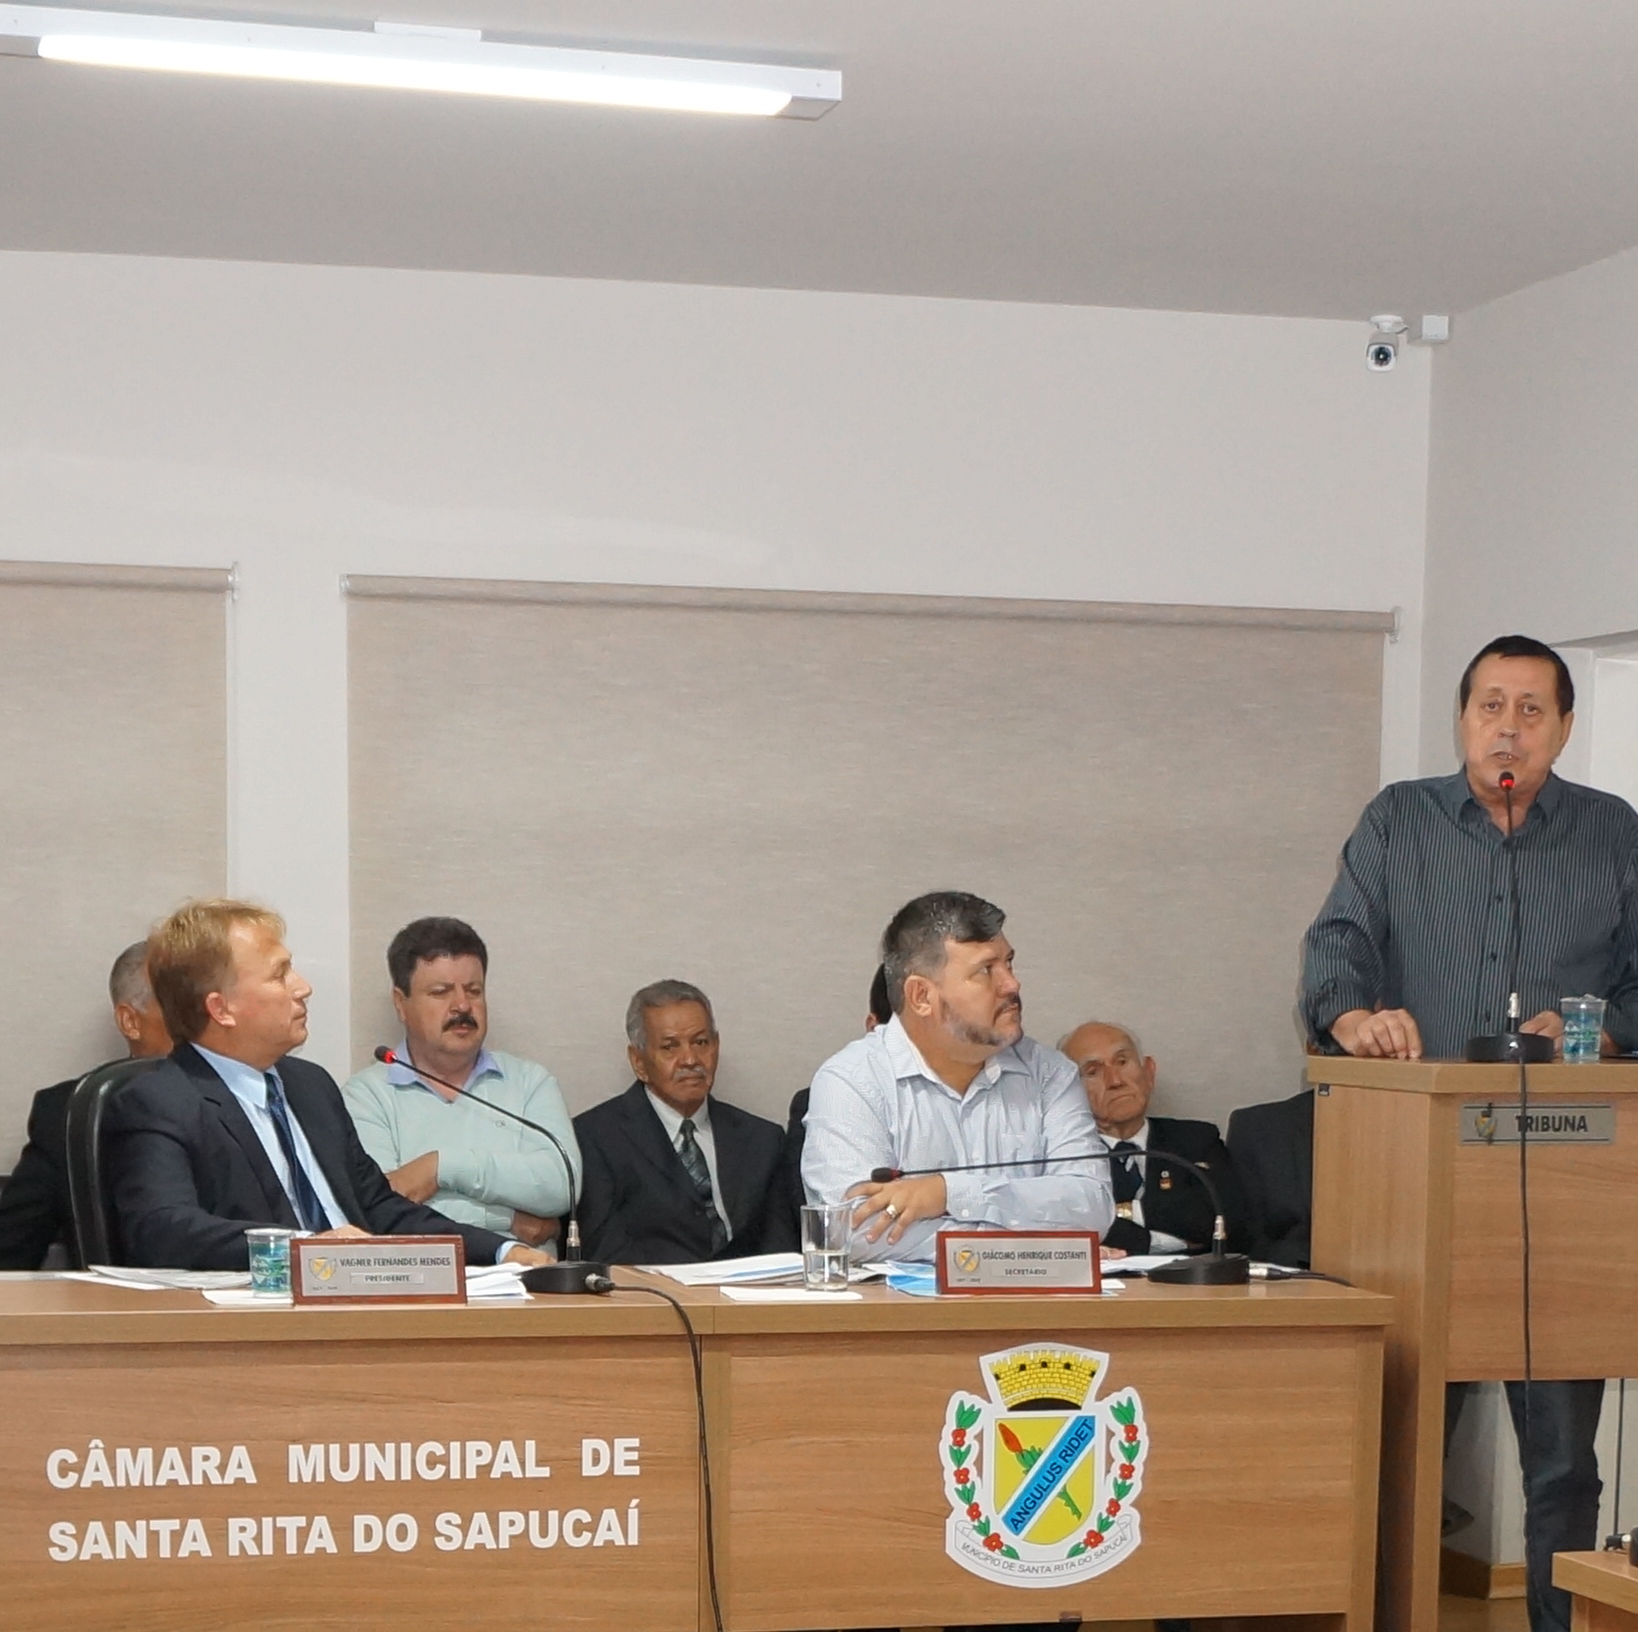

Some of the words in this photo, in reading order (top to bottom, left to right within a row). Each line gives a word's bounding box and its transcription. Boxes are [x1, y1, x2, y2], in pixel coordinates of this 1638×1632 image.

[1515, 1115, 1589, 1133] TRIBUNA
[339, 1257, 372, 1267] VAGNER
[373, 1257, 418, 1267] FERNANDES
[419, 1257, 451, 1266] MENDES
[364, 1274, 411, 1283] PRESIDENTE
[46, 1439, 257, 1489] CÂMARA
[288, 1439, 551, 1483] MUNICIPAL
[581, 1438, 640, 1477] DE
[1010, 1461, 1065, 1531] ANGULUS
[1061, 1418, 1095, 1464] RIDET
[48, 1518, 212, 1562] SANTA
[228, 1516, 338, 1556] RITA
[353, 1513, 418, 1553] DO
[434, 1499, 640, 1551] SAPUCAÍ
[1001, 1560, 1016, 1572] DE
[1017, 1563, 1052, 1575] SANTA
[1053, 1560, 1077, 1573] RITA
[1077, 1554, 1093, 1567] DO
